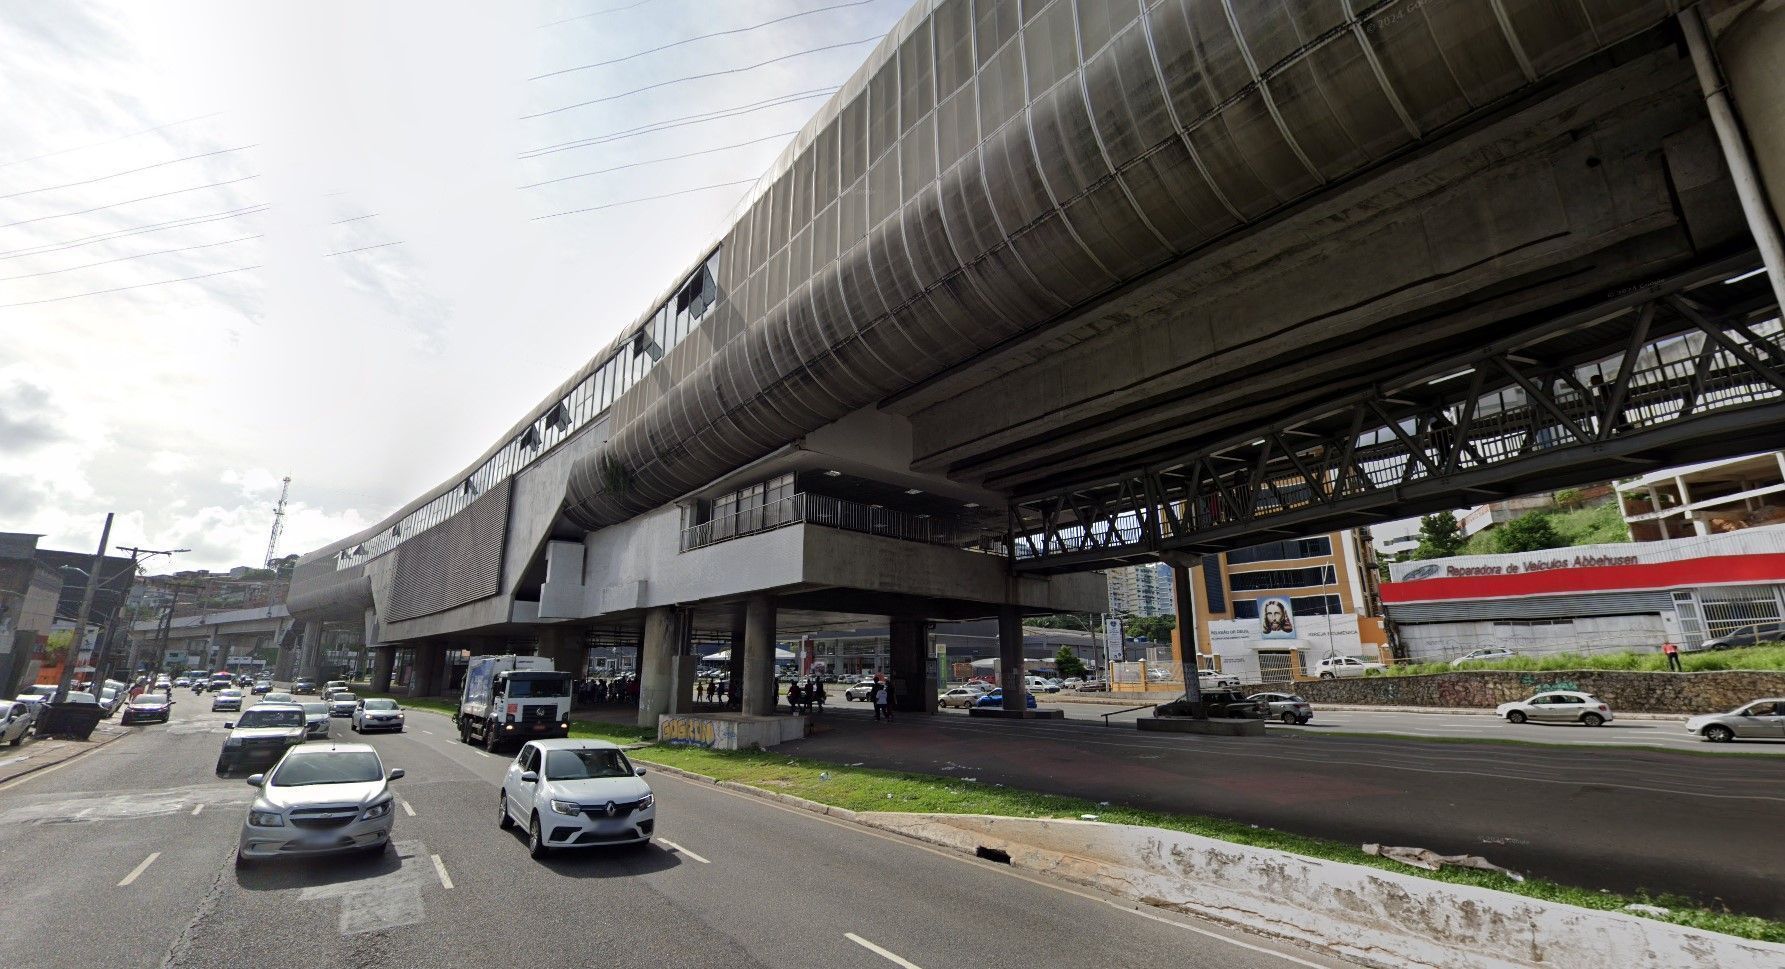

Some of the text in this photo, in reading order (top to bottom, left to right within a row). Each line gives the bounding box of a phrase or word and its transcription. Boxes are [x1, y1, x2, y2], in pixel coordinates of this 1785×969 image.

[1446, 565, 1502, 577] Reparadora
[1505, 563, 1519, 574] de
[1523, 558, 1568, 572] Veículos
[1573, 554, 1638, 568] Abbehusen
